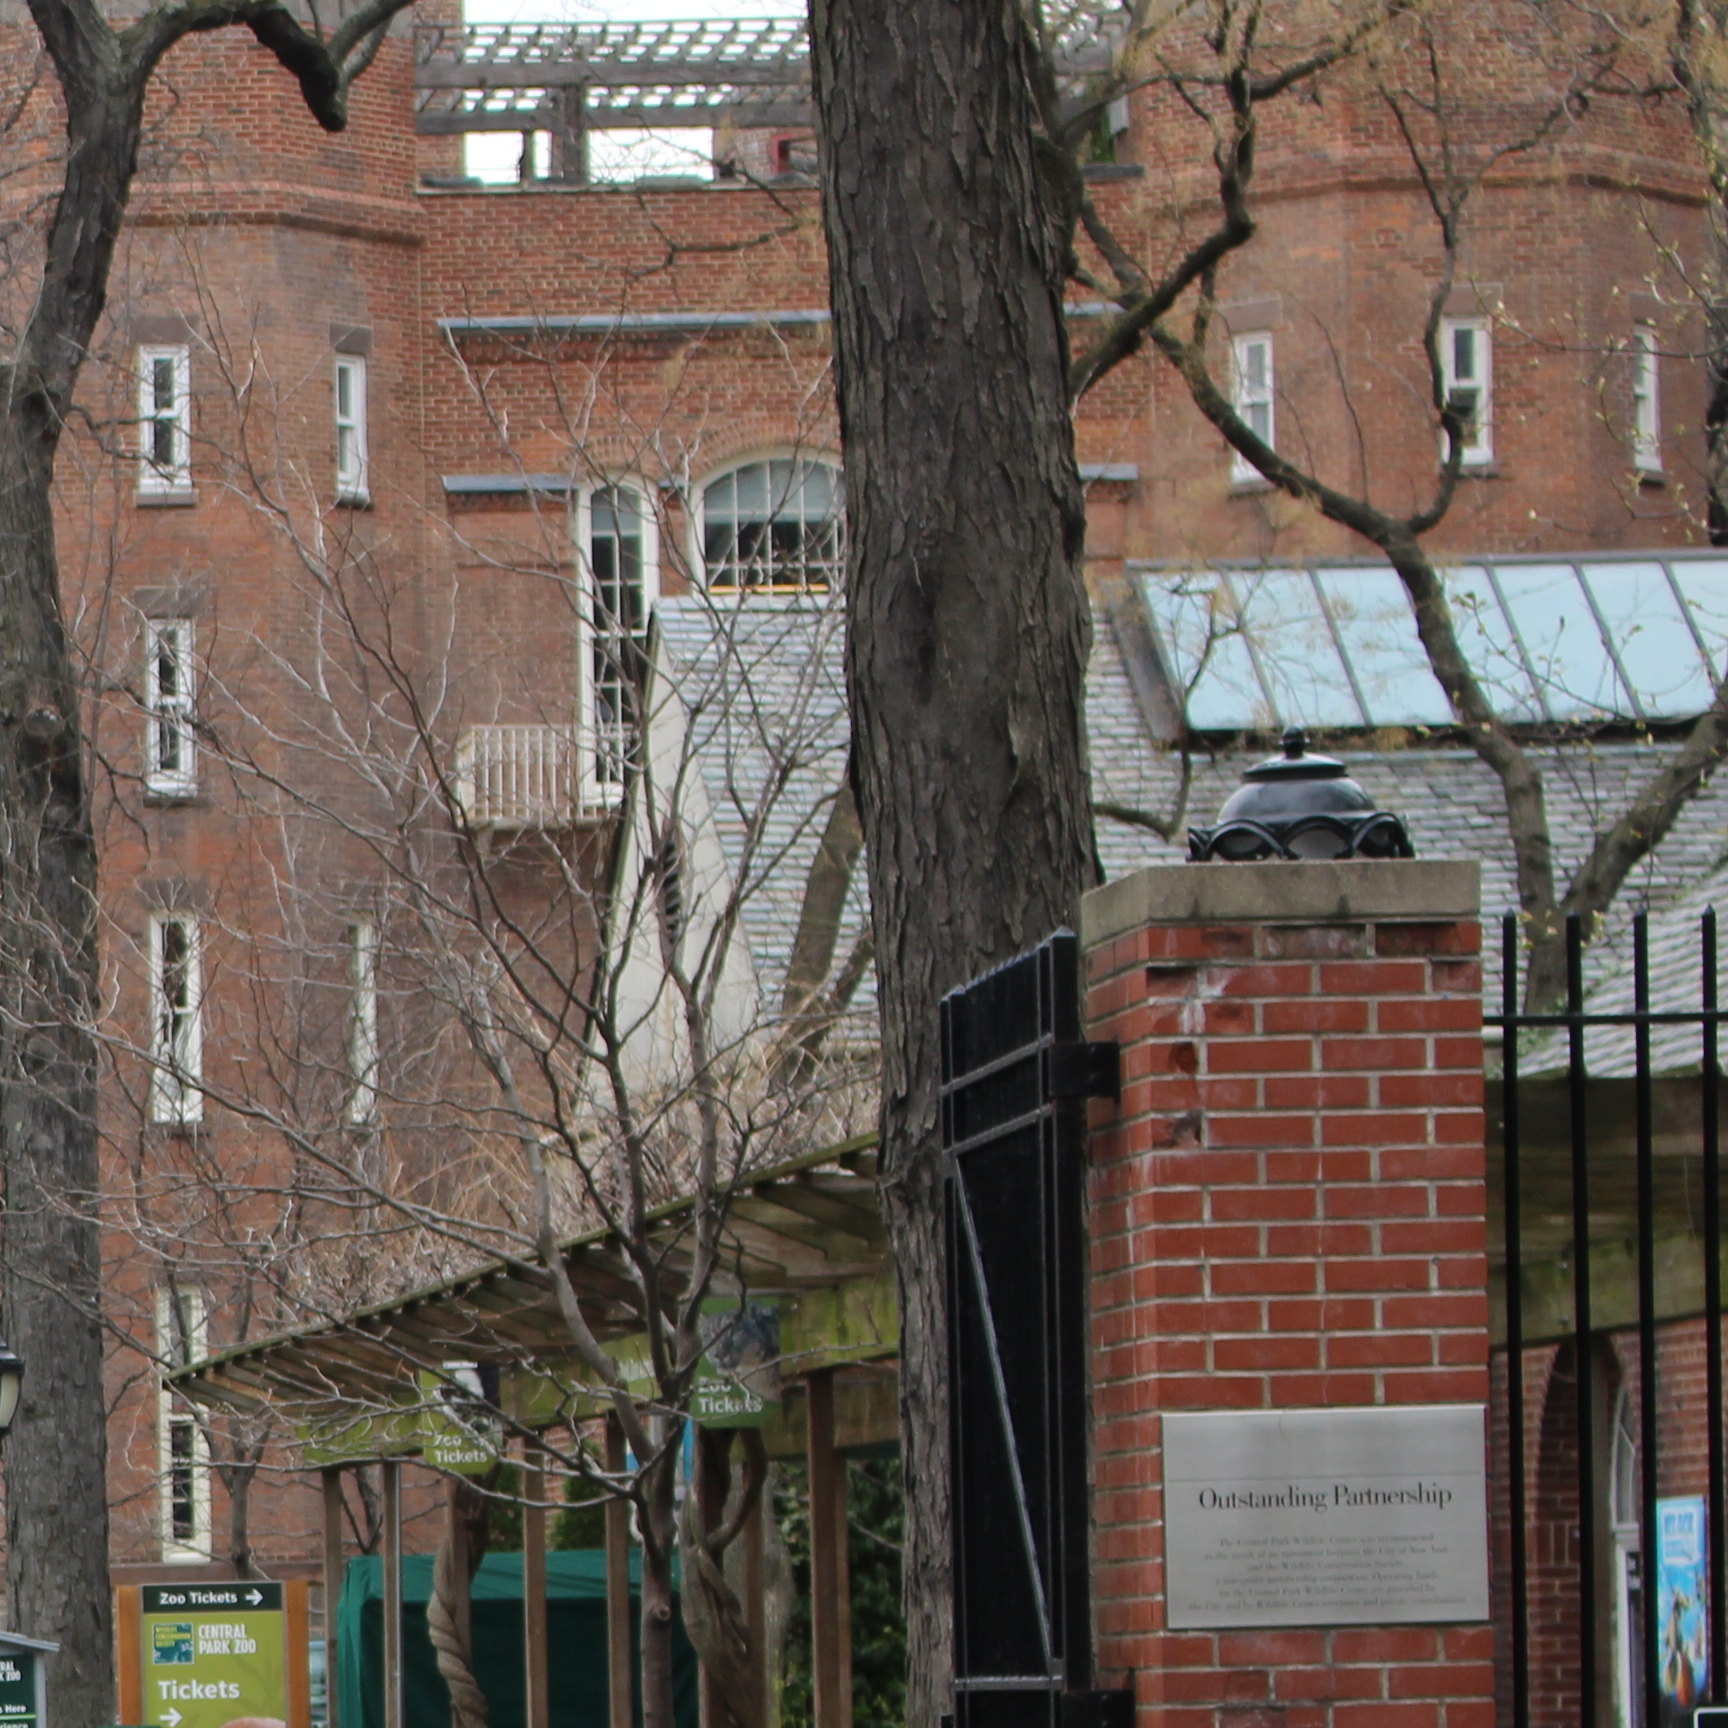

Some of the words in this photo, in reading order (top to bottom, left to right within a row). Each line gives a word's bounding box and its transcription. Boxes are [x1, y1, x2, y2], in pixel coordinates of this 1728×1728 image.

[434, 1449, 488, 1463] Tickets
[1198, 1485, 1328, 1513] Outstanding
[1333, 1482, 1453, 1512] Partnership
[159, 1592, 187, 1605] Zoo
[189, 1591, 238, 1604] Tickets
[198, 1623, 248, 1640] CENTRAL
[199, 1639, 231, 1655] PARK
[234, 1638, 257, 1654] ZOO
[158, 1680, 241, 1700] Tickets
[4, 1703, 27, 1714] Here
